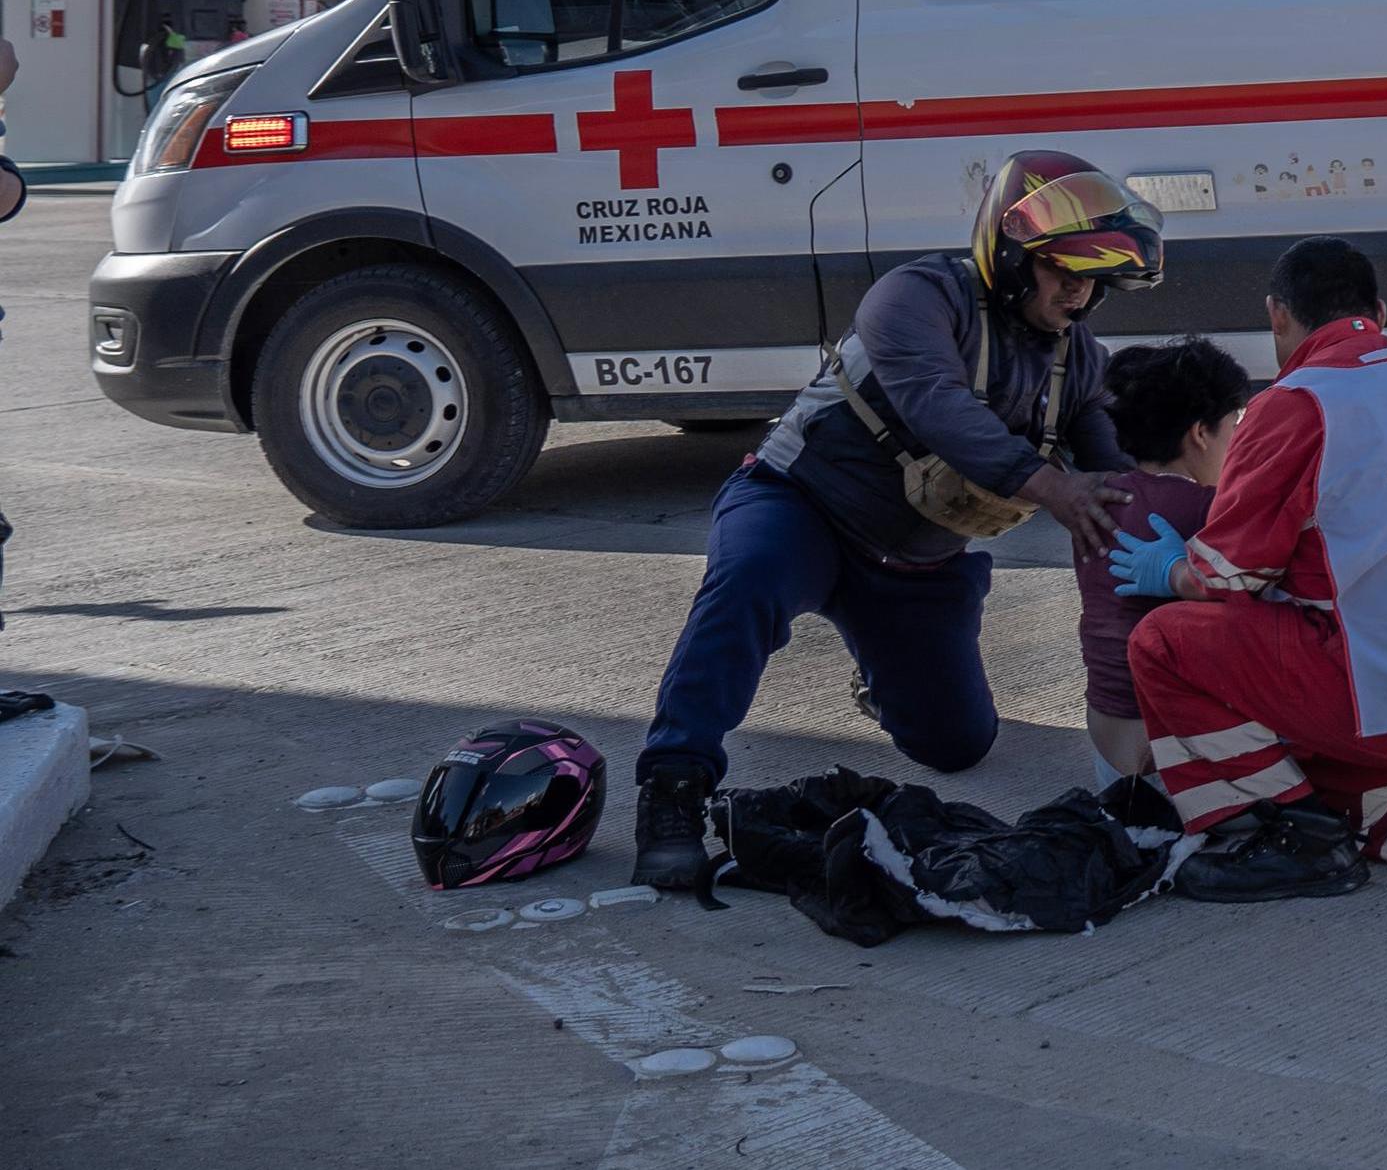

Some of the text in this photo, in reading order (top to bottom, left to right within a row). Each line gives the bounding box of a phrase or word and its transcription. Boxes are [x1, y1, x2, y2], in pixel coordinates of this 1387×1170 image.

[576, 196, 709, 219] CRUZ ROJA
[579, 221, 712, 244] MEXICANA
[595, 356, 712, 386] BC-167
